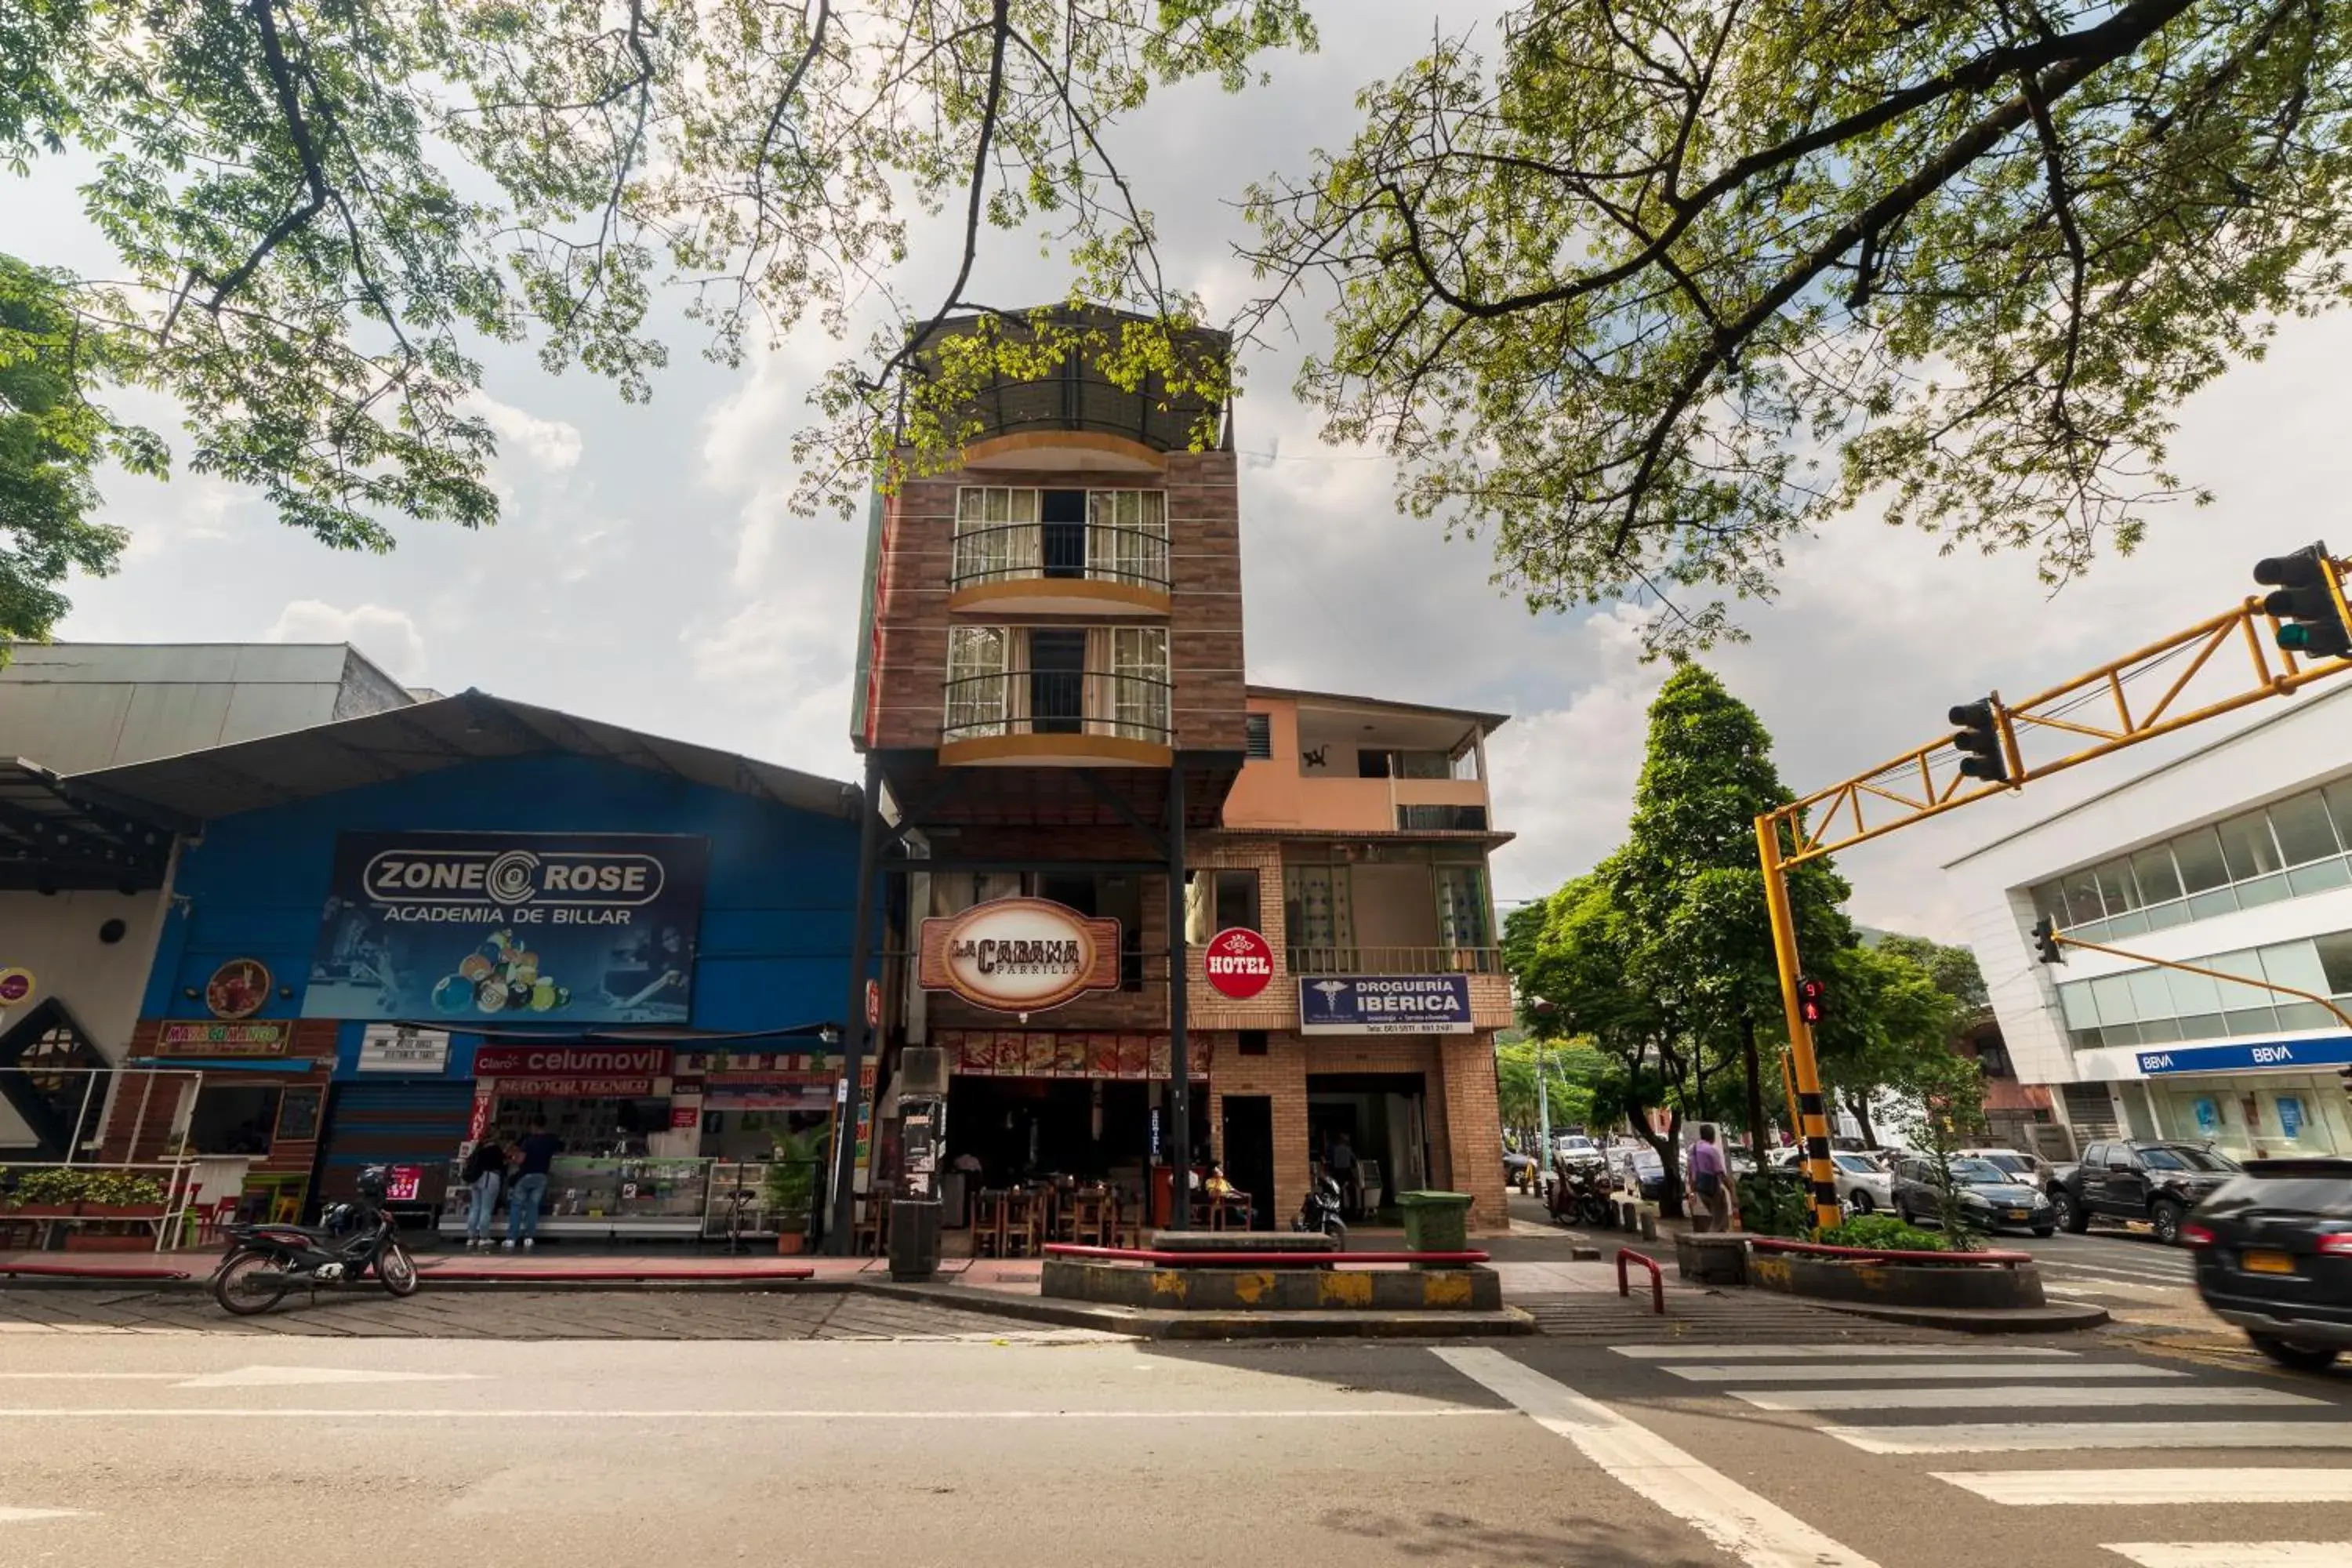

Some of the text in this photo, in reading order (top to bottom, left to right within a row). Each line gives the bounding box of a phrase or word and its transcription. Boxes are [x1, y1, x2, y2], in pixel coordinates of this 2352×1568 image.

[376, 860, 648, 892] ZONE ROSE
[383, 906, 632, 925] ACADEMIA DE BILLAR
[996, 965, 1080, 975] PARRILLA
[1209, 956, 1270, 975] HOTEL
[1356, 978, 1454, 993] DROGUERÍA
[1806, 984, 1816, 996] 9
[1357, 993, 1461, 1012] IBÉRICA
[479, 1048, 663, 1070] Claro celumovil
[2142, 1054, 2174, 1070] BBVA
[2252, 1045, 2293, 1062] BBVA
[498, 1080, 576, 1092] SERVICIO
